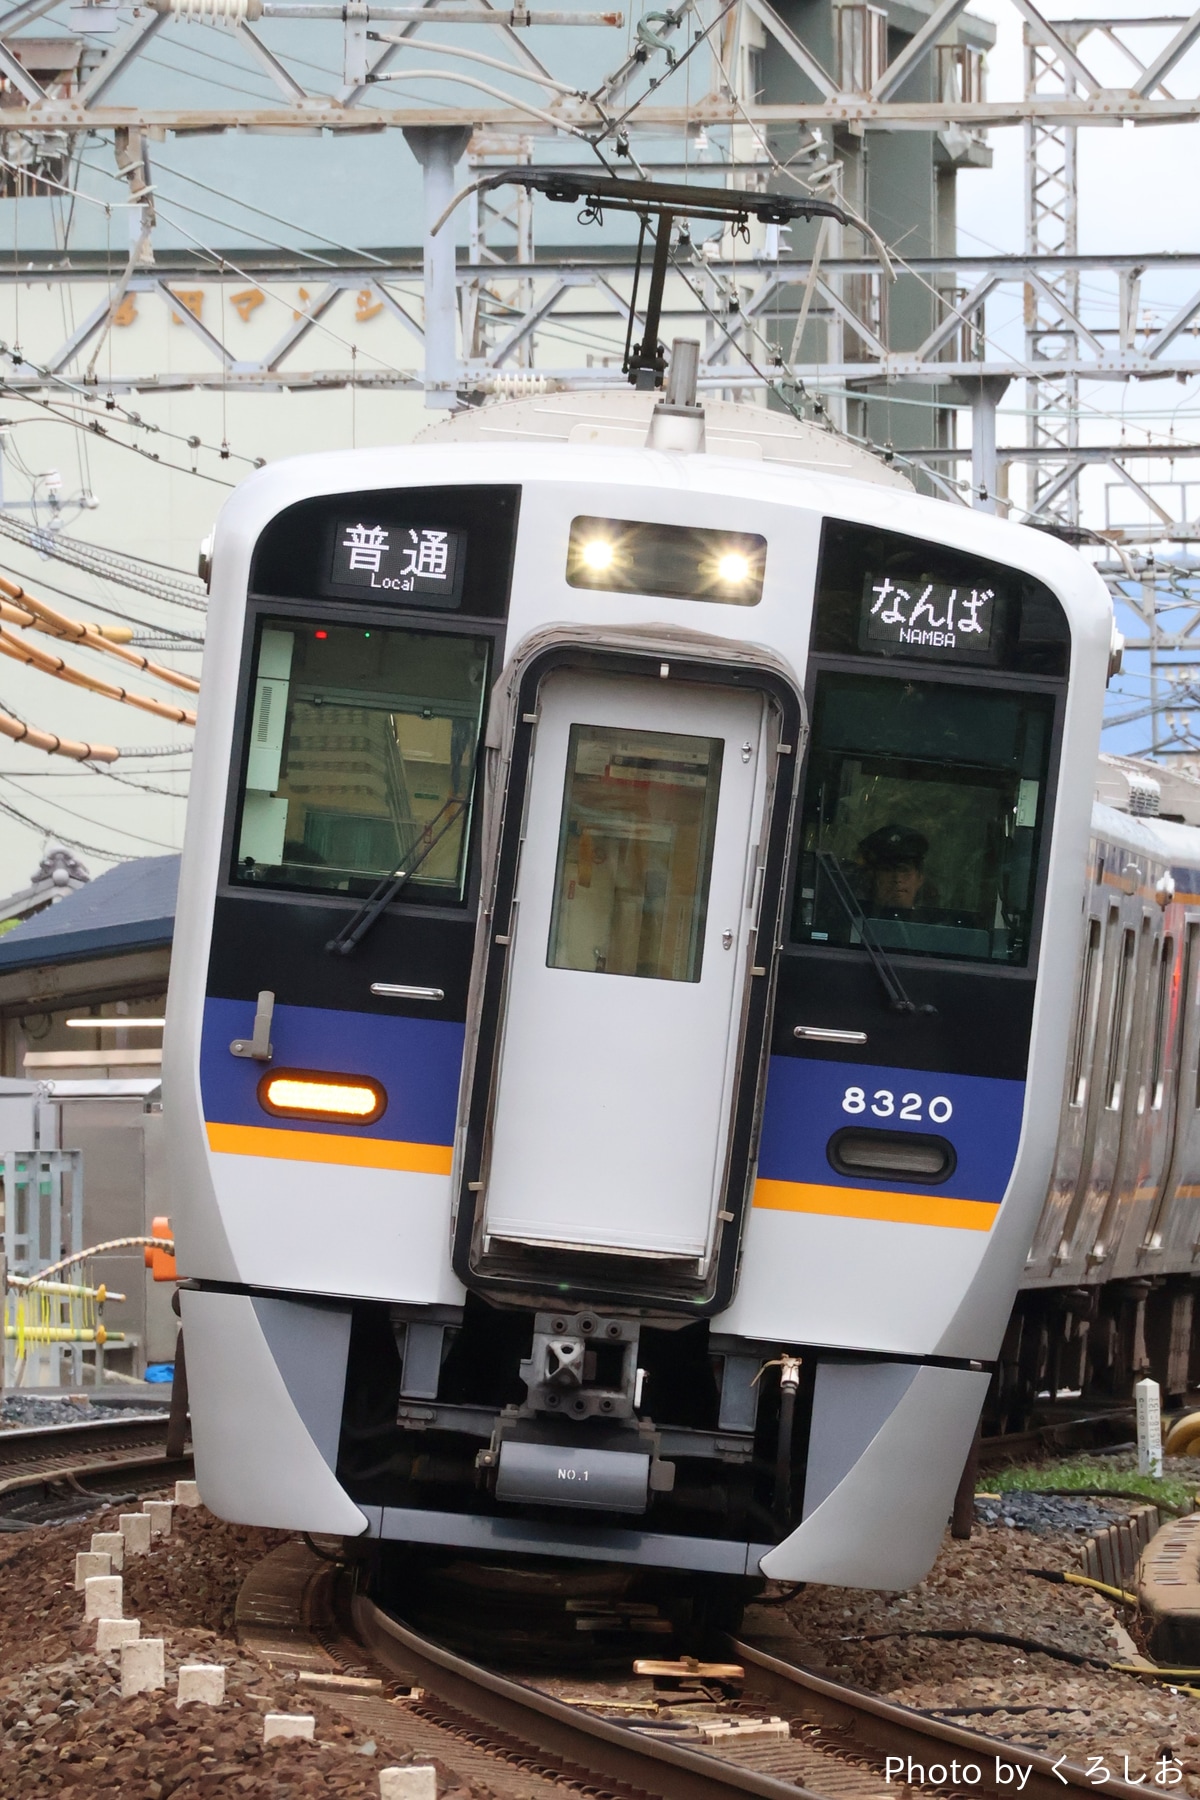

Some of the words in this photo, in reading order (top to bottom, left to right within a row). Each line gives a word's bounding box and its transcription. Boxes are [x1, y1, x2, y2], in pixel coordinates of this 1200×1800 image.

[342, 523, 448, 580] 普通
[370, 572, 415, 592] Local
[870, 578, 995, 633] なんば
[899, 627, 956, 648] NAMBA
[842, 1086, 953, 1123] 8320
[557, 1468, 589, 1481] NO.1
